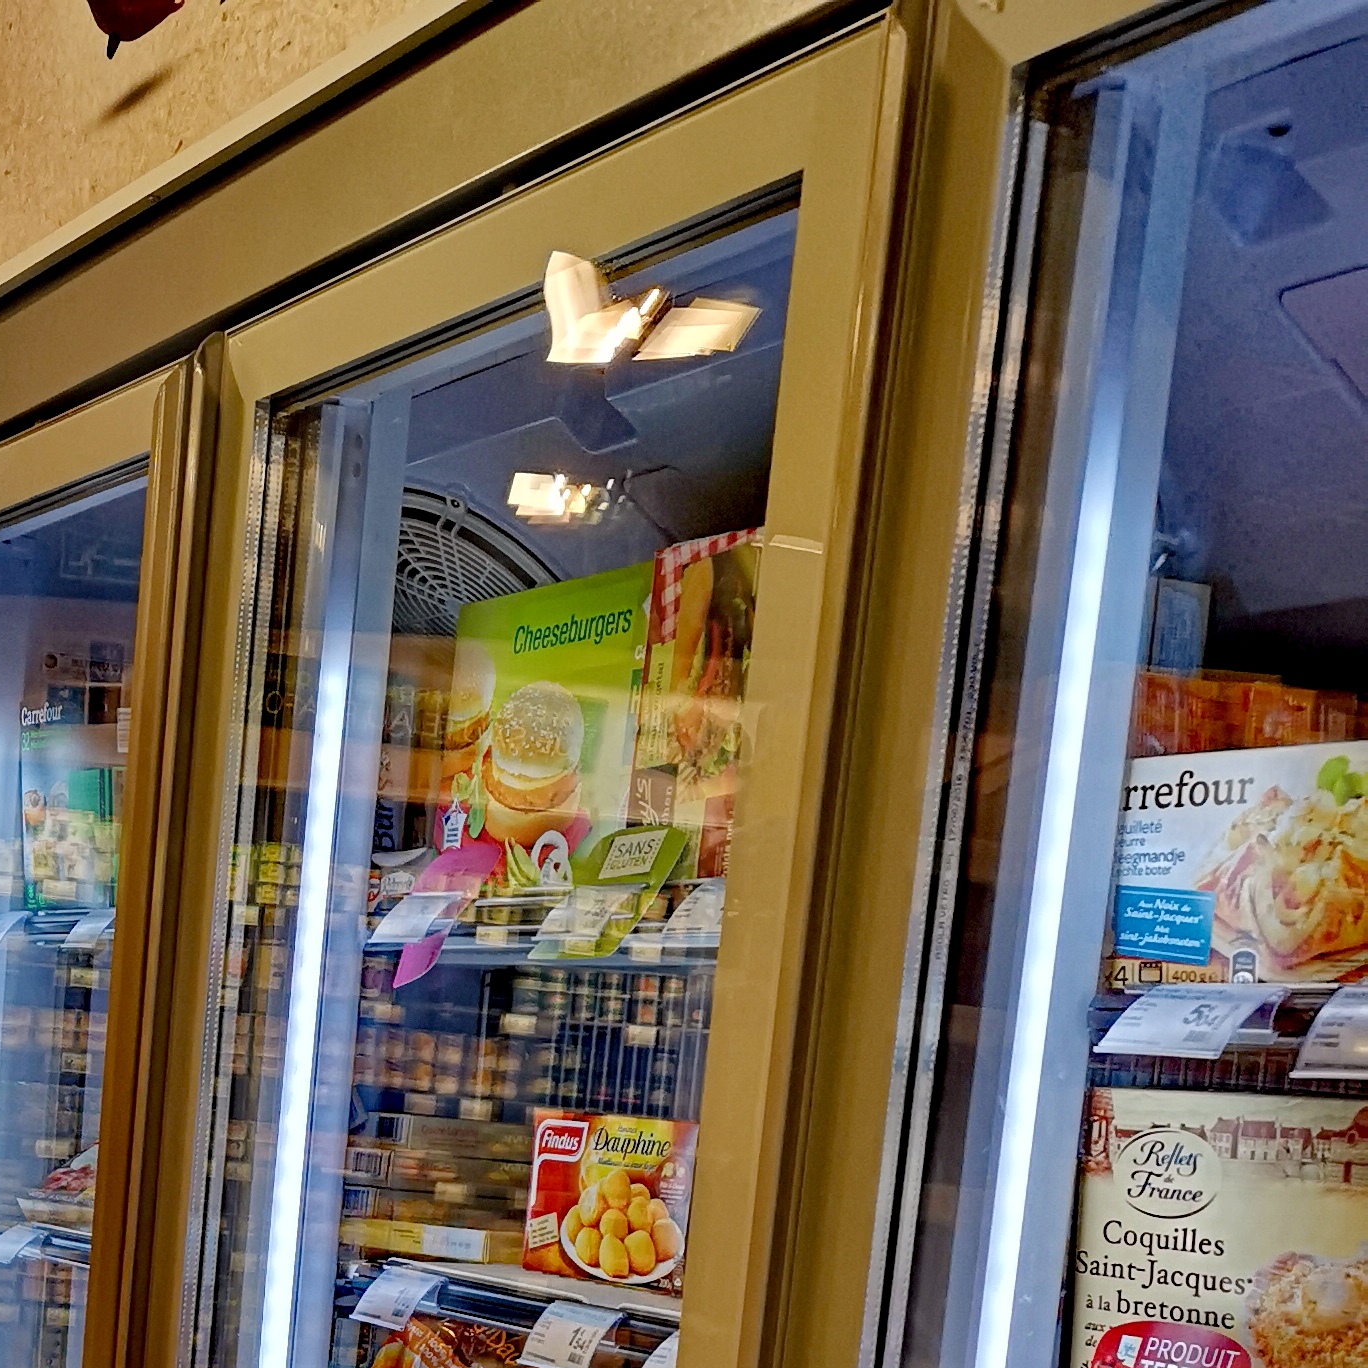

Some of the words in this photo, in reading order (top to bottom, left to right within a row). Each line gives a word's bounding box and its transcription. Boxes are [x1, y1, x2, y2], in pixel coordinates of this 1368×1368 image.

[513, 607, 632, 655] Cheeseburgers
[21, 701, 63, 727] Carrefour
[1122, 770, 1255, 812] rrefour
[614, 837, 656, 859] SANS
[541, 1129, 581, 1151] Findus
[591, 1124, 672, 1162] Dauphine
[1127, 1169, 1204, 1203] France
[1103, 1219, 1225, 1257] Coquilles
[1085, 1294, 1095, 1309] à
[1097, 1295, 1112, 1312] la
[1116, 1290, 1236, 1329] bretonne
